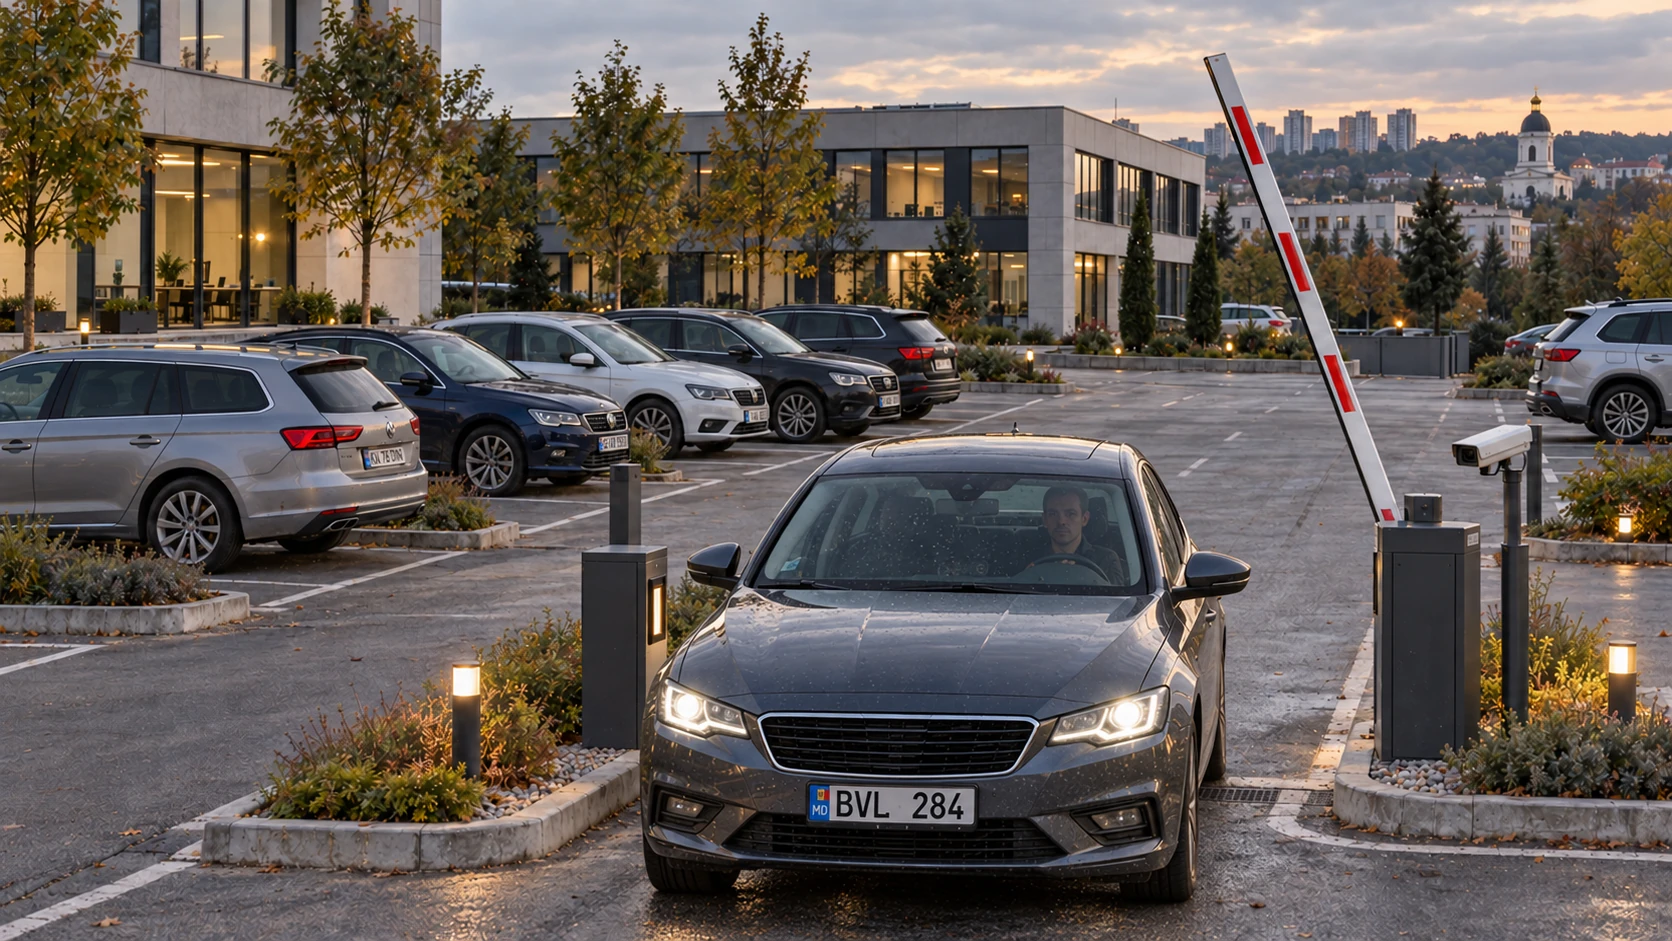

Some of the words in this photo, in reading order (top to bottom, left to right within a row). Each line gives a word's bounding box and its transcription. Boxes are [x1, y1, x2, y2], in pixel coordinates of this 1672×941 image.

[812, 804, 828, 816] MD
[836, 790, 890, 819] BVL
[912, 791, 964, 820] 284
